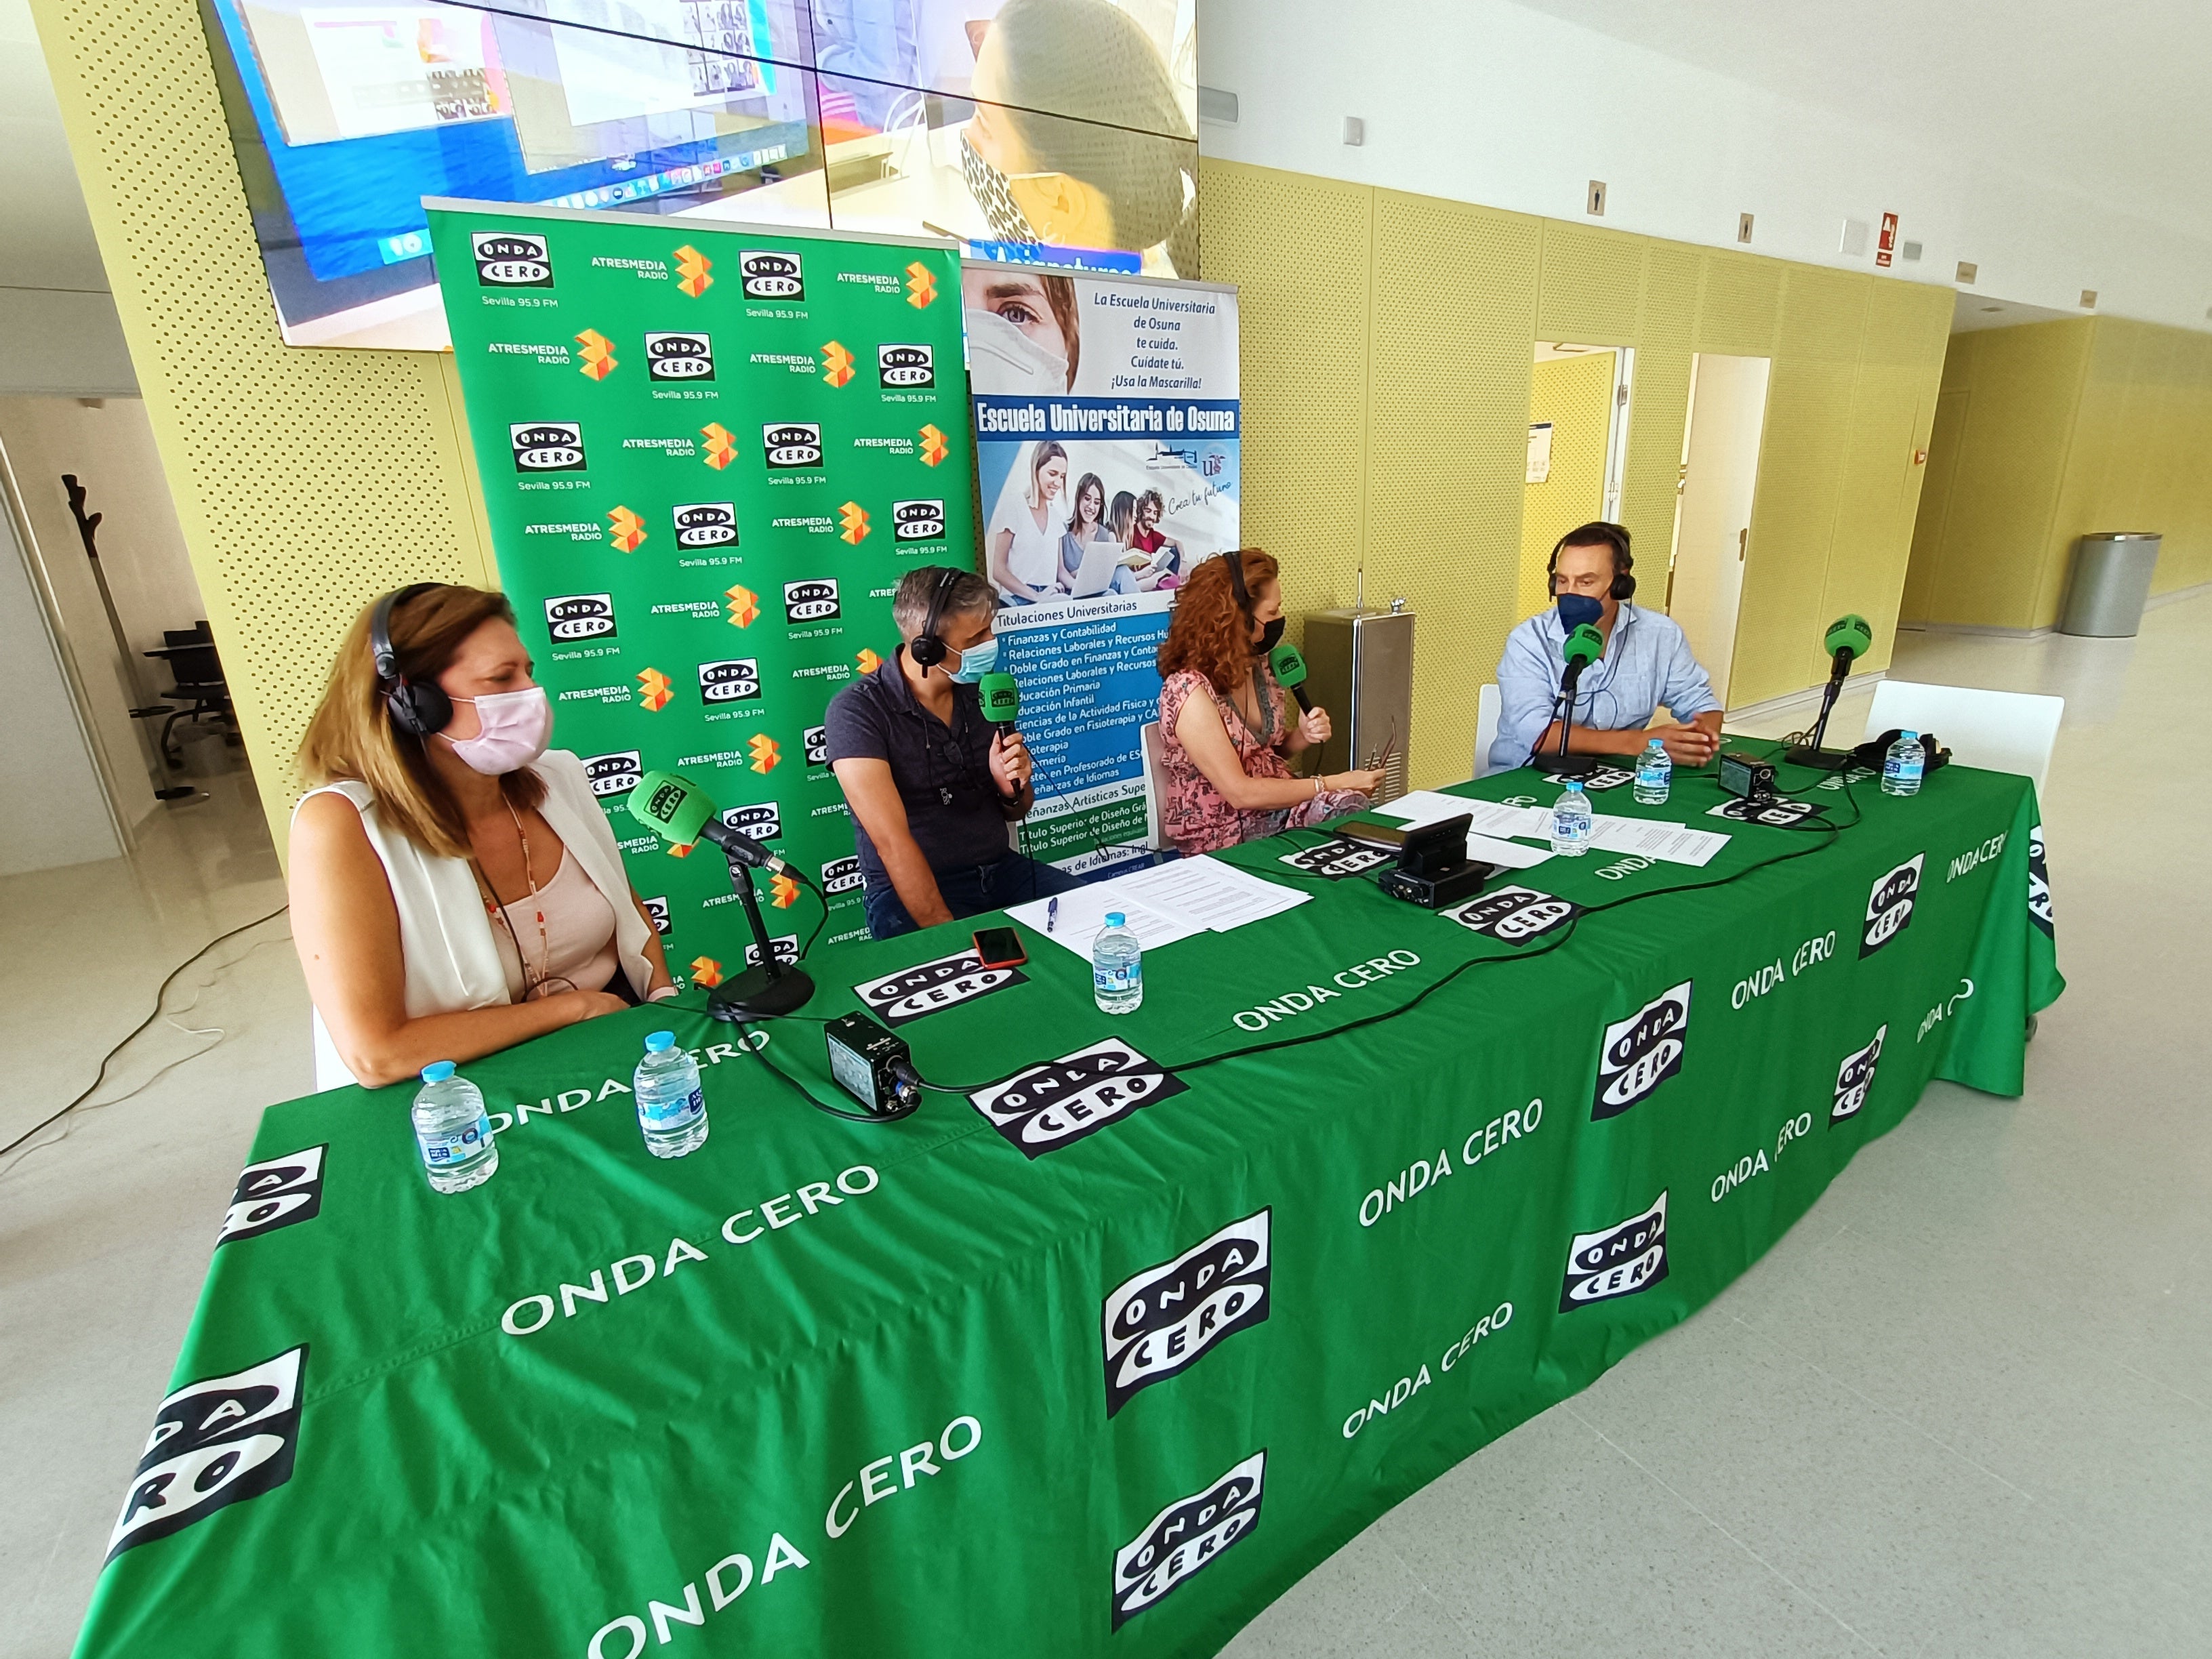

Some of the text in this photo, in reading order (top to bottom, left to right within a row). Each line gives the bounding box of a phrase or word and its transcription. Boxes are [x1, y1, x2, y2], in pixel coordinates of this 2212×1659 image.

[483, 243, 537, 256] ONDA
[491, 266, 539, 277] CERO
[592, 258, 667, 271] ATRESMEDIA
[749, 262, 792, 272] ONDA
[638, 271, 668, 281] RADIO
[837, 273, 899, 285] ATRESMEDIA
[754, 281, 794, 291] CERO
[875, 285, 900, 293] RADIO
[482, 296, 558, 308] Sevilla 95.9 FM
[1094, 293, 1215, 314] La Escuela Universitaria
[746, 309, 808, 319] Sevilla 95.9 FM
[1134, 317, 1180, 331] de Osuna
[489, 344, 568, 355] ATRESMEDIA
[655, 342, 701, 352] ONDA
[1136, 338, 1178, 350] te cuida.
[538, 356, 569, 364] RADIO
[750, 354, 815, 365] ATRESMEDIA
[886, 354, 924, 363] ONDA
[1131, 356, 1184, 369] Cuídate tú.
[661, 363, 703, 372] CERO
[790, 365, 815, 373] RADIO
[890, 371, 925, 380] CERO
[1111, 375, 1202, 390] ¡Usa la Mascarilla!
[977, 403, 1234, 432] Escuela Universitaria de Osuna
[521, 433, 571, 443] ONDA
[529, 453, 574, 462] CERO
[518, 481, 550, 490] Sevilla
[552, 481, 573, 489] 95.9
[1168, 482, 1231, 514] Crea tu futuro
[525, 523, 600, 534] ATRESMEDIA
[571, 533, 602, 541] RADIO
[556, 604, 602, 616] ONDA
[997, 600, 1137, 627] Titulaciones Universitarias
[562, 622, 605, 634] CERO
[1008, 622, 1116, 646] Finanzas y Contabilidad
[1009, 634, 1155, 660] Relaciones Laborales y Recursos
[552, 651, 581, 660] Sevilla
[584, 650, 604, 658] 95.9
[1010, 663, 1037, 675] Doble
[1040, 658, 1069, 670] Grado
[1084, 651, 1121, 663] Finanzas
[1124, 651, 1129, 659] y
[1066, 667, 1107, 680] Laborales
[1109, 665, 1114, 675] y
[1117, 659, 1156, 672] Recursos
[792, 665, 848, 678] ATRESMEDIA
[558, 686, 630, 701] ATRESMEDIA
[602, 694, 631, 703] RADIO
[1019, 687, 1060, 702] ducación
[1063, 680, 1100, 695] Primaria
[1018, 694, 1094, 716] ducación Infantil
[1015, 718, 1052, 731] Ciencias
[1055, 714, 1066, 723] de
[1069, 712, 1077, 721] la
[1080, 702, 1120, 718] Actividad
[1149, 699, 1154, 707] y
[1023, 714, 1143, 743] oble Grado en Fisioterapia y
[678, 751, 741, 766] ATRESMEDIA
[717, 758, 742, 768] RADIO
[1050, 754, 1126, 778] en Profesorado de
[1086, 769, 1119, 783] Idiomas
[1072, 790, 1118, 808] Artísticas
[1089, 814, 1099, 823] de
[1101, 808, 1129, 821] Diseño
[1051, 831, 1087, 846] Superior
[1102, 819, 1130, 832] Diseño
[1132, 816, 1142, 825] de
[1075, 861, 1086, 870] de
[1462, 892, 1536, 922] ONDA
[1502, 903, 1561, 933] CERO
[881, 960, 979, 995] ONDA
[1732, 931, 1835, 1009] ONDA CERO
[904, 974, 998, 1009] CERO
[1233, 950, 1420, 1031] ONDA CERO
[1620, 1008, 1674, 1058] ONDA
[1619, 1044, 1671, 1097] CERO
[489, 1079, 632, 1135] ONDA
[1039, 1078, 1147, 1131] CERO
[1359, 1099, 1542, 1227] ONDA CERO
[1711, 1149, 1769, 1202] ONDA
[1588, 1219, 1658, 1264] ONDA
[501, 1166, 879, 1334] ONDA CERO
[1588, 1254, 1654, 1295] CERO
[1126, 1248, 1244, 1325] ONDA
[1134, 1292, 1244, 1368] CERO
[1343, 1303, 1513, 1439] ONDA CERO
[1137, 1486, 1241, 1568] ONDA
[588, 1416, 981, 1659] ONDA CERO
[1143, 1519, 1241, 1596] CERO
